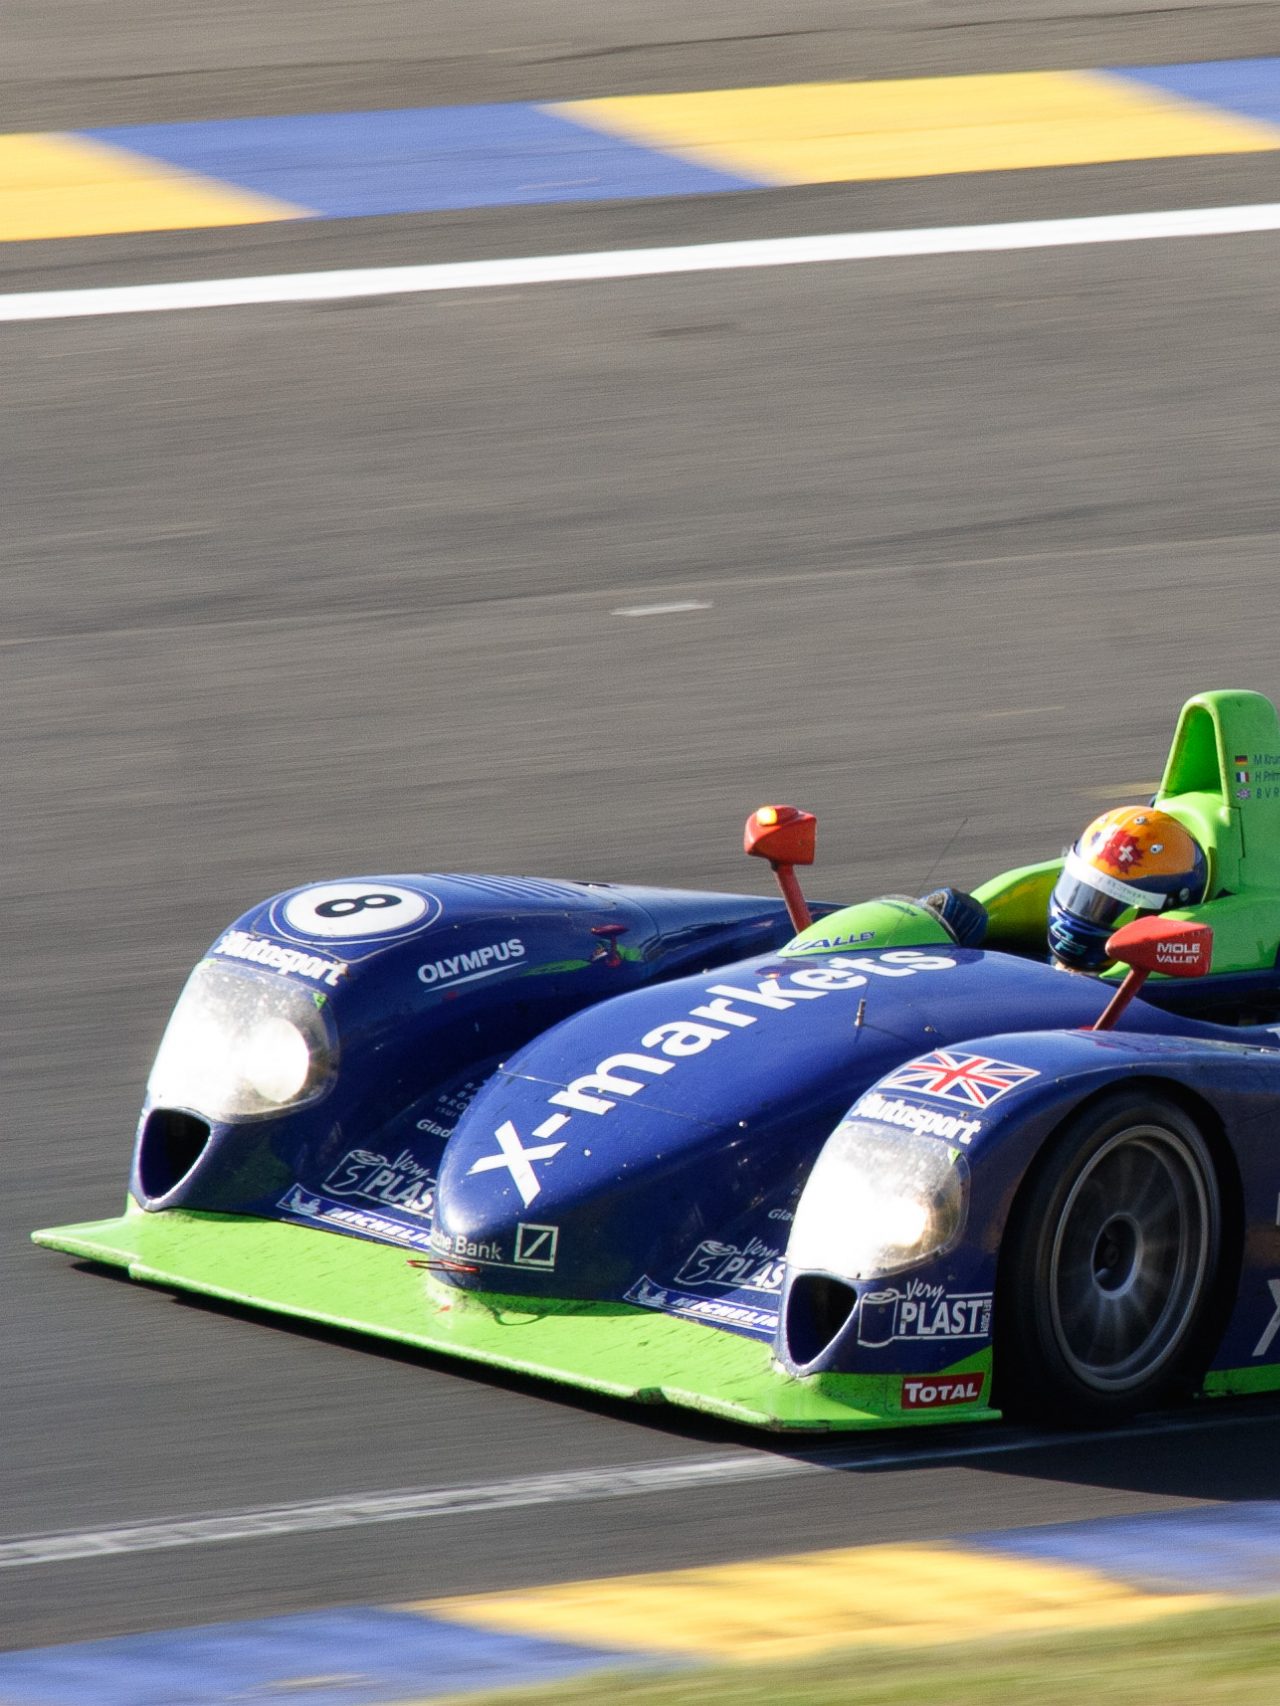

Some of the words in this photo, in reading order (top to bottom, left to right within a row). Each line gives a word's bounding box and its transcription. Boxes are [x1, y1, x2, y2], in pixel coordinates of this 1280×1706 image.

[315, 893, 402, 918] 8
[213, 930, 350, 987] Autosport
[417, 938, 526, 985] OLYMPUS
[1156, 942, 1201, 954] MOLE
[1156, 954, 1200, 964] VALLEY
[851, 1091, 982, 1145] Autosport
[364, 1169, 434, 1216] PLAS
[454, 1233, 503, 1261] Bank
[715, 1256, 786, 1290] PLAS
[906, 1278, 946, 1309] Very
[898, 1299, 984, 1336] PLAST
[904, 1382, 979, 1404] TOTAL
